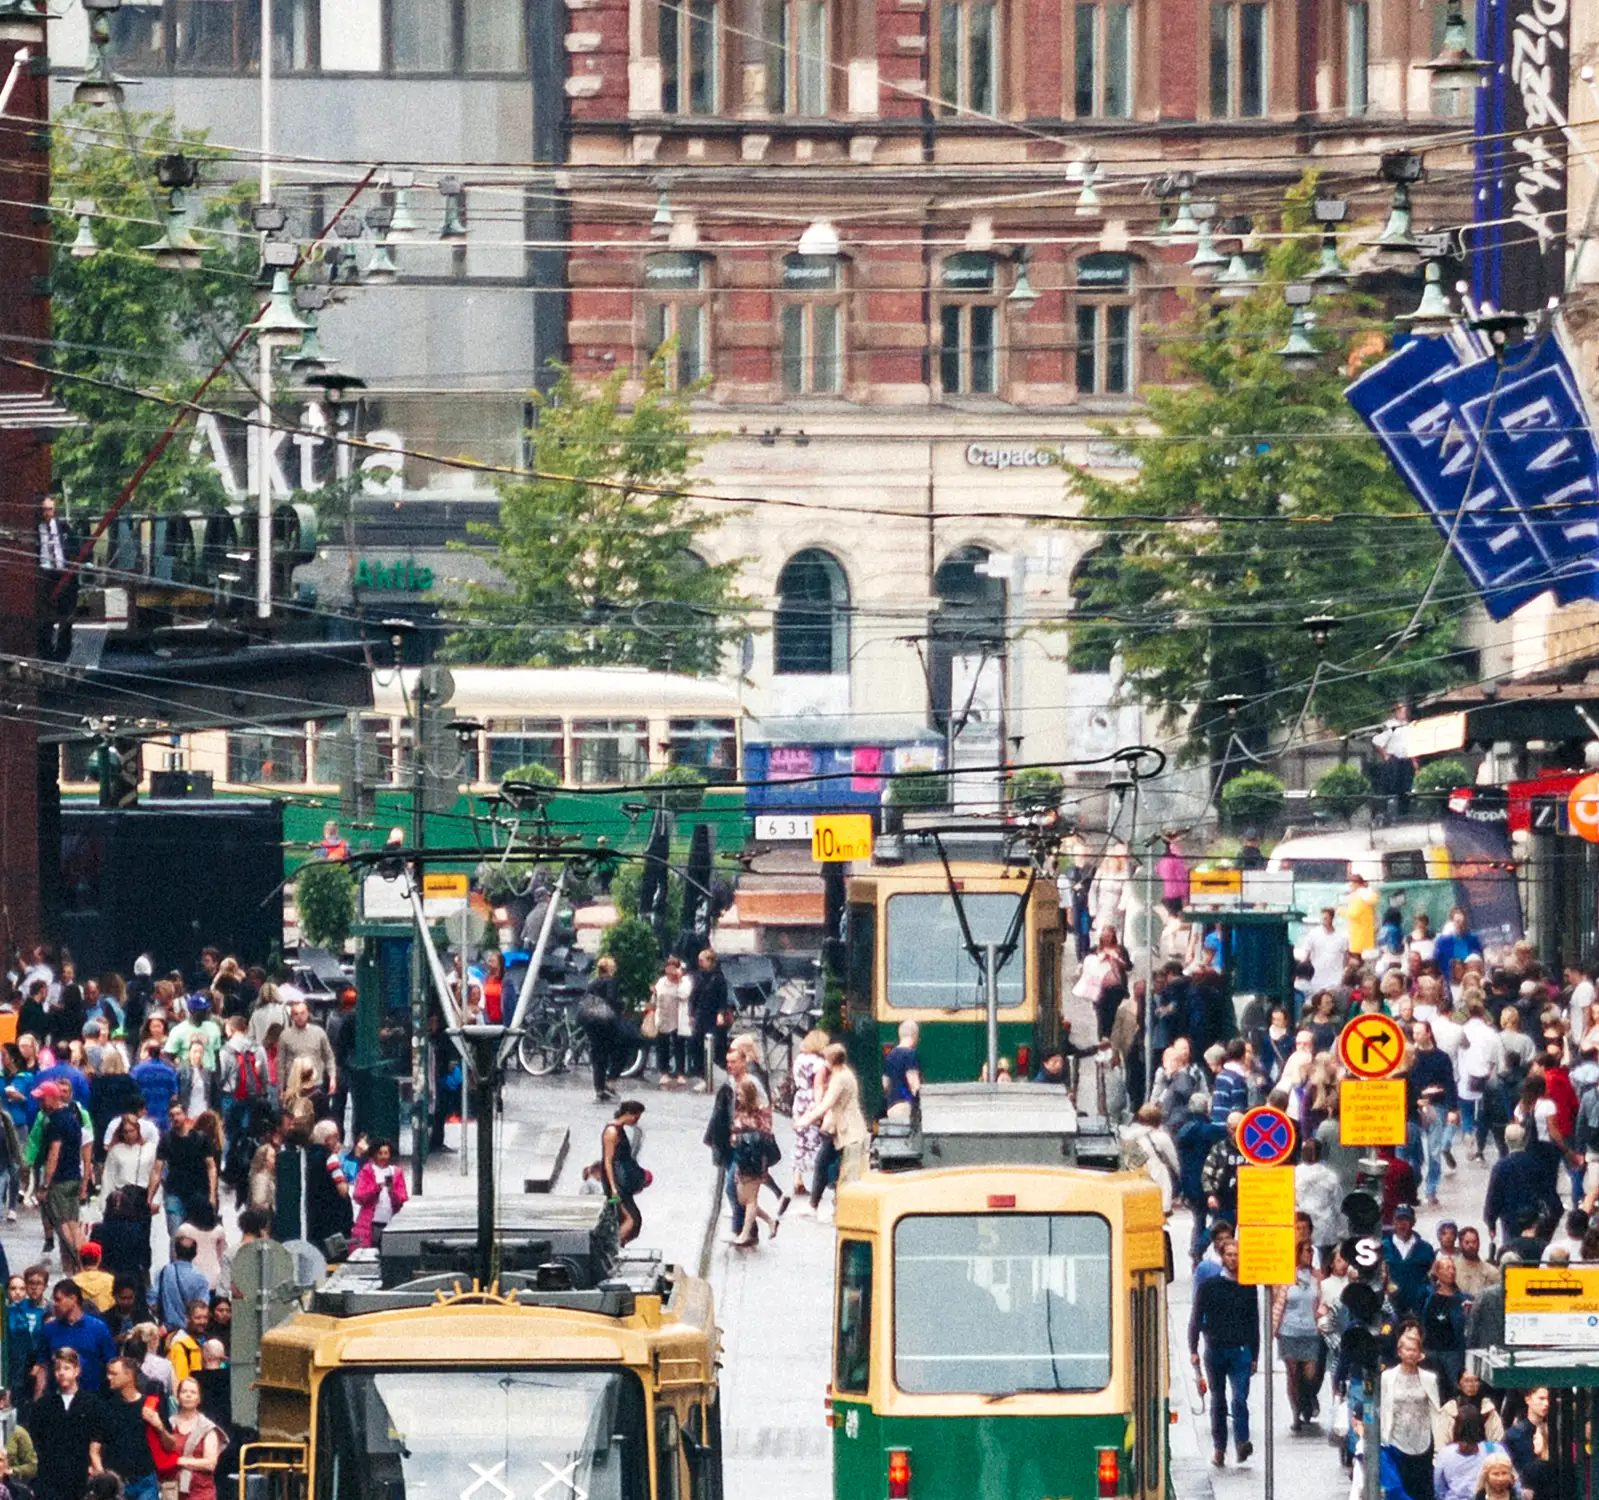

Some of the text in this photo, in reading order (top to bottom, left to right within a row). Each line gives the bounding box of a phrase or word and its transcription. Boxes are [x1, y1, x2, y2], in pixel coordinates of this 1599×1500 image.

[353, 560, 435, 590] Aktia
[815, 828, 834, 857] 10
[1355, 1238, 1378, 1266] S
